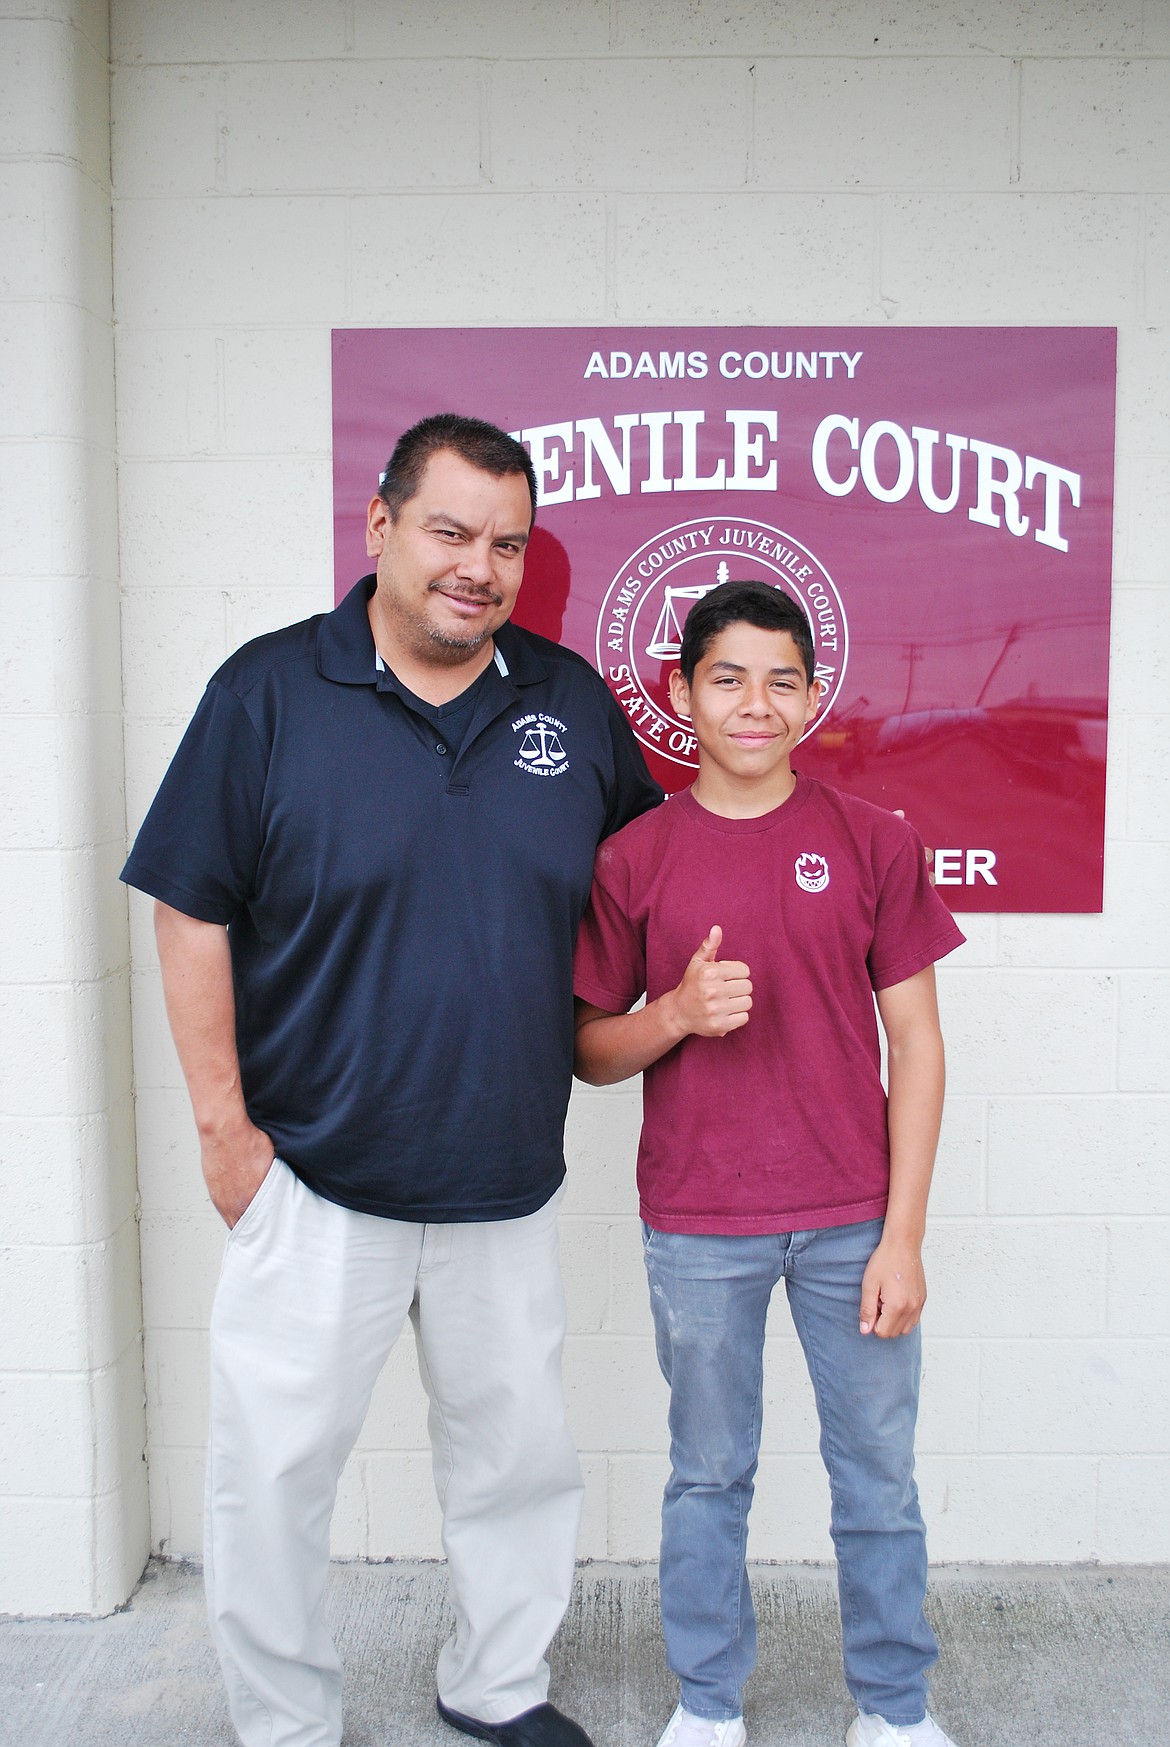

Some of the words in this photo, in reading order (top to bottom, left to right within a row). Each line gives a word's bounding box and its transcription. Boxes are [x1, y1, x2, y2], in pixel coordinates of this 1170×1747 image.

[583, 350, 709, 379] ADAMS
[718, 350, 863, 379] COUNTY
[379, 410, 778, 507] ENILE
[810, 413, 1081, 553] COURT
[607, 576, 642, 653] ADAMS
[637, 525, 715, 577] COUNTY
[719, 528, 814, 583] JUVENILE
[807, 582, 838, 652] COURT
[511, 714, 538, 733] ADAMS
[538, 712, 568, 733] COUNTY
[609, 664, 670, 742] STATE
[668, 731, 699, 756] OF
[513, 758, 549, 776] JUVENILE
[549, 760, 570, 777] COURT
